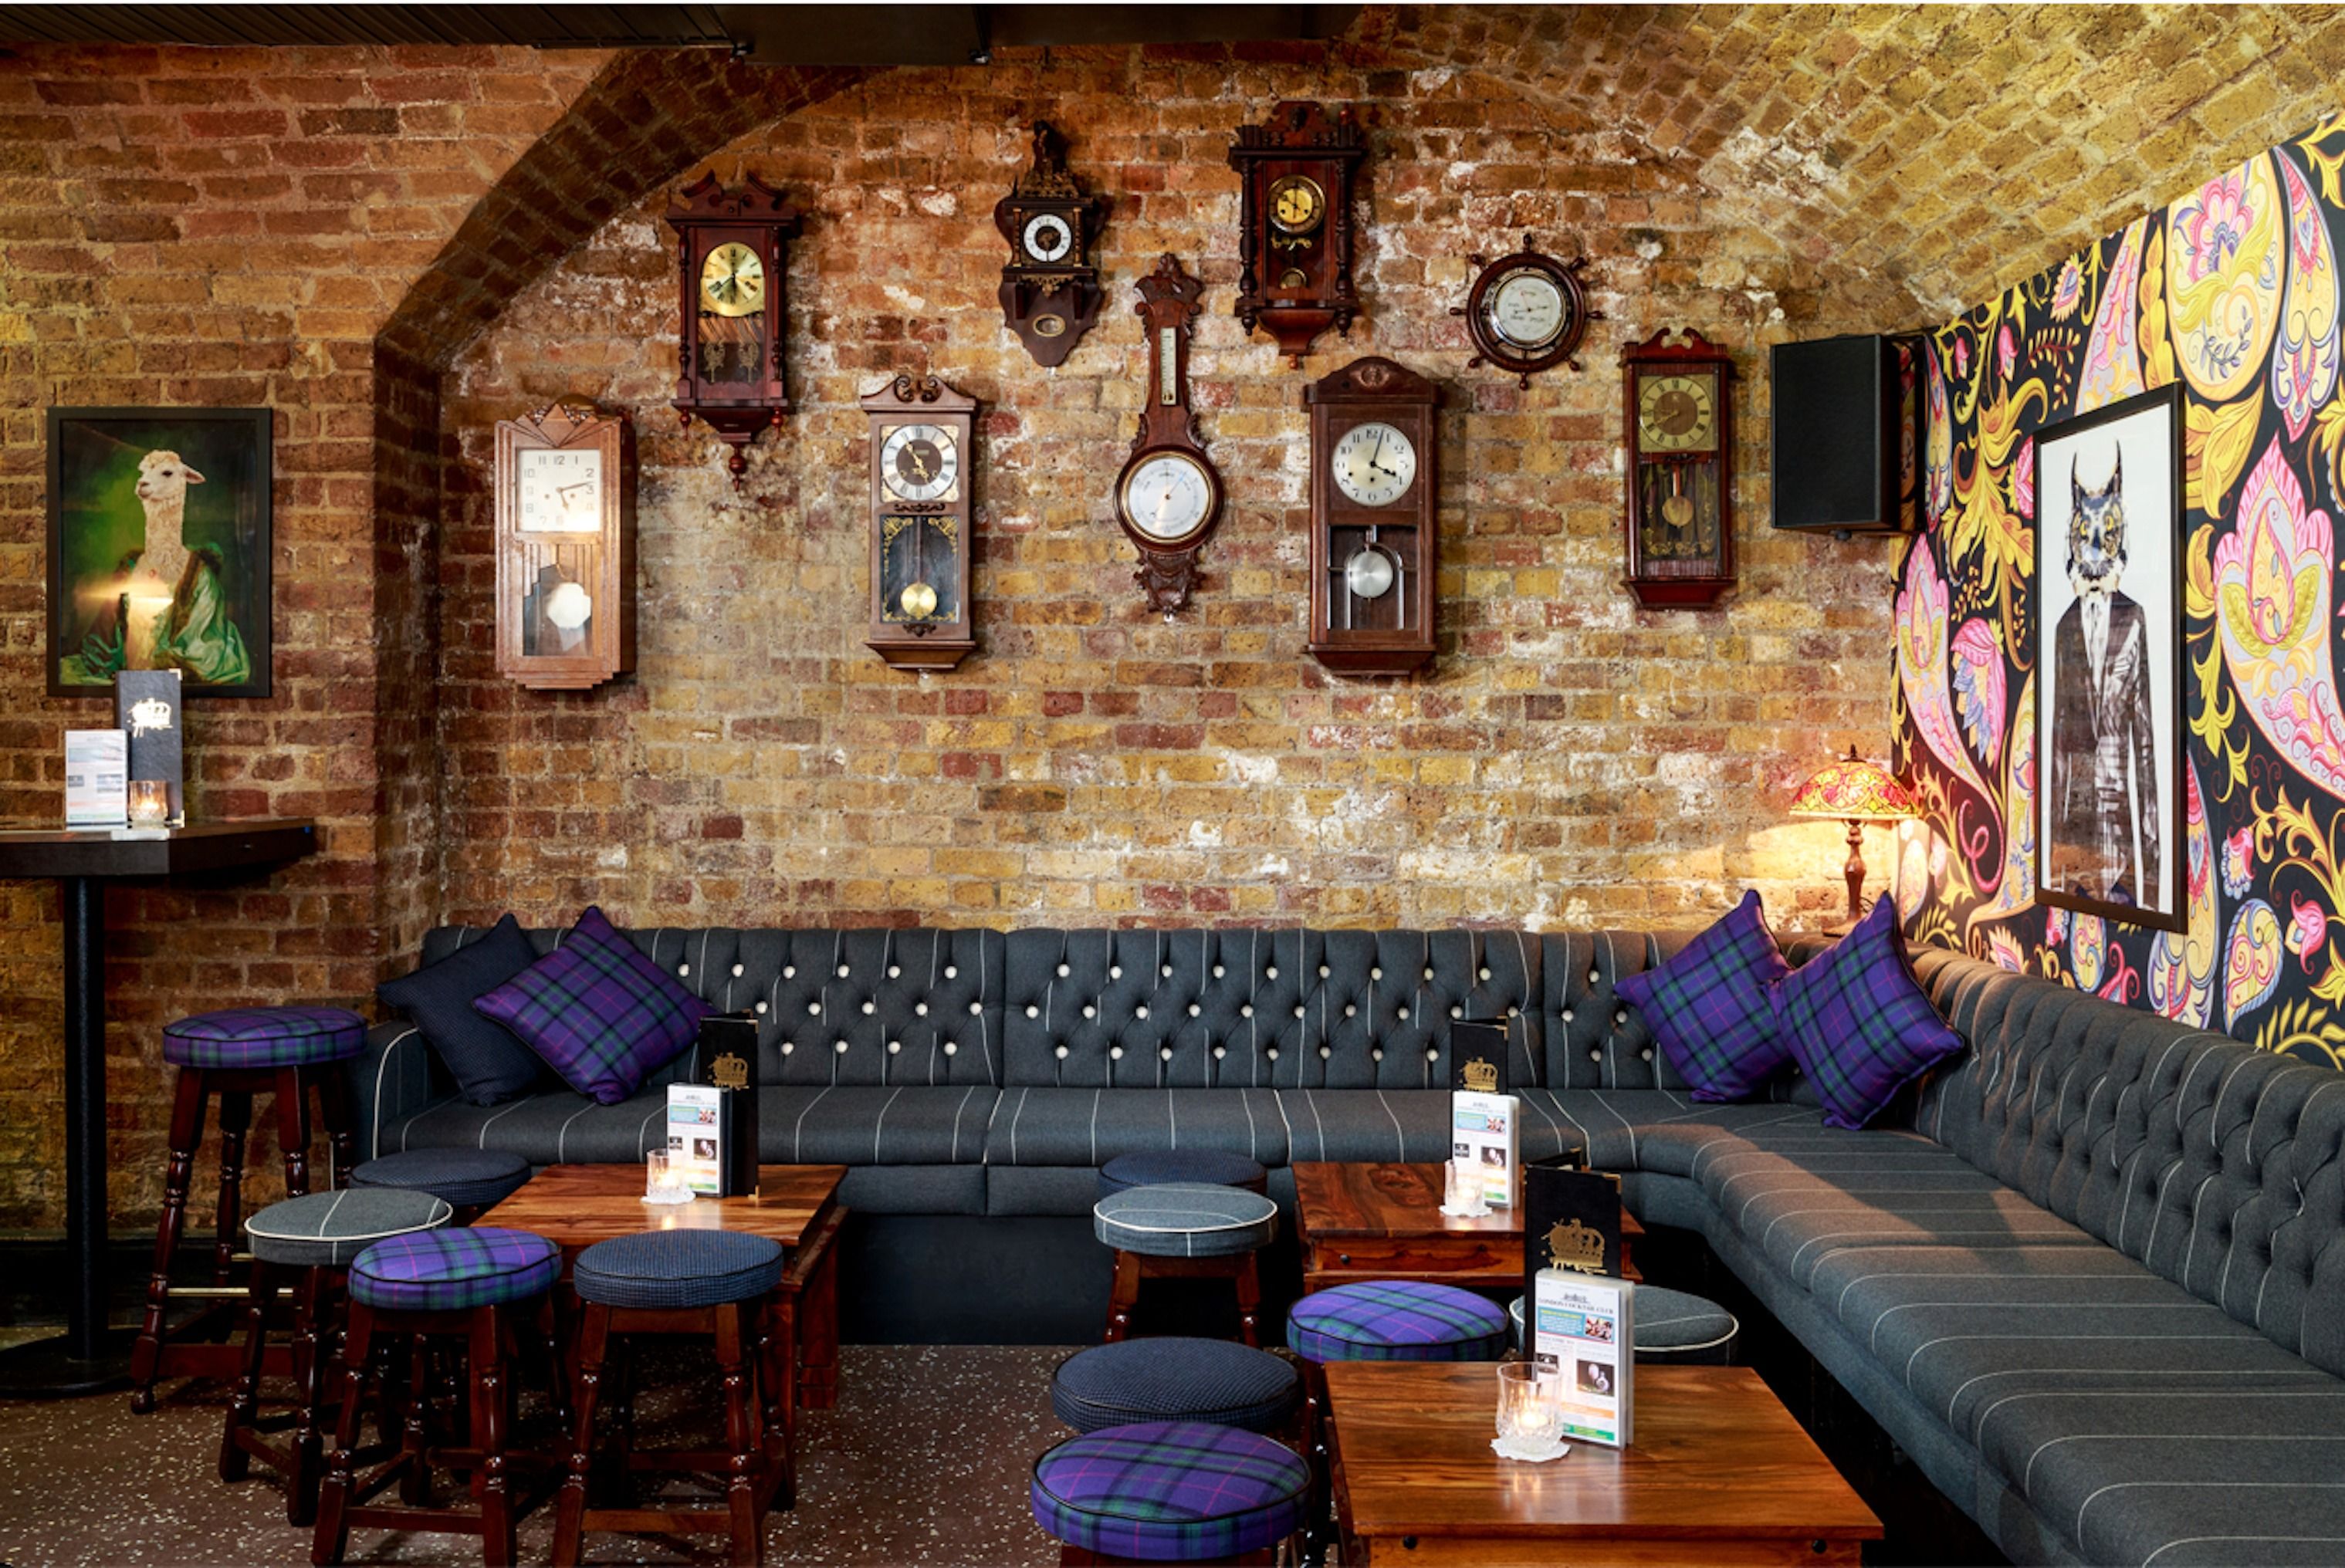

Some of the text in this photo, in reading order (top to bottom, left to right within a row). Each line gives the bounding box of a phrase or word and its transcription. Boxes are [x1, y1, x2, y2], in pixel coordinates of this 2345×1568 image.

[1352, 434, 1360, 443] 11
[538, 455, 547, 465] 11
[553, 455, 565, 465] 12
[524, 468, 536, 478] 10
[585, 468, 594, 478] 2
